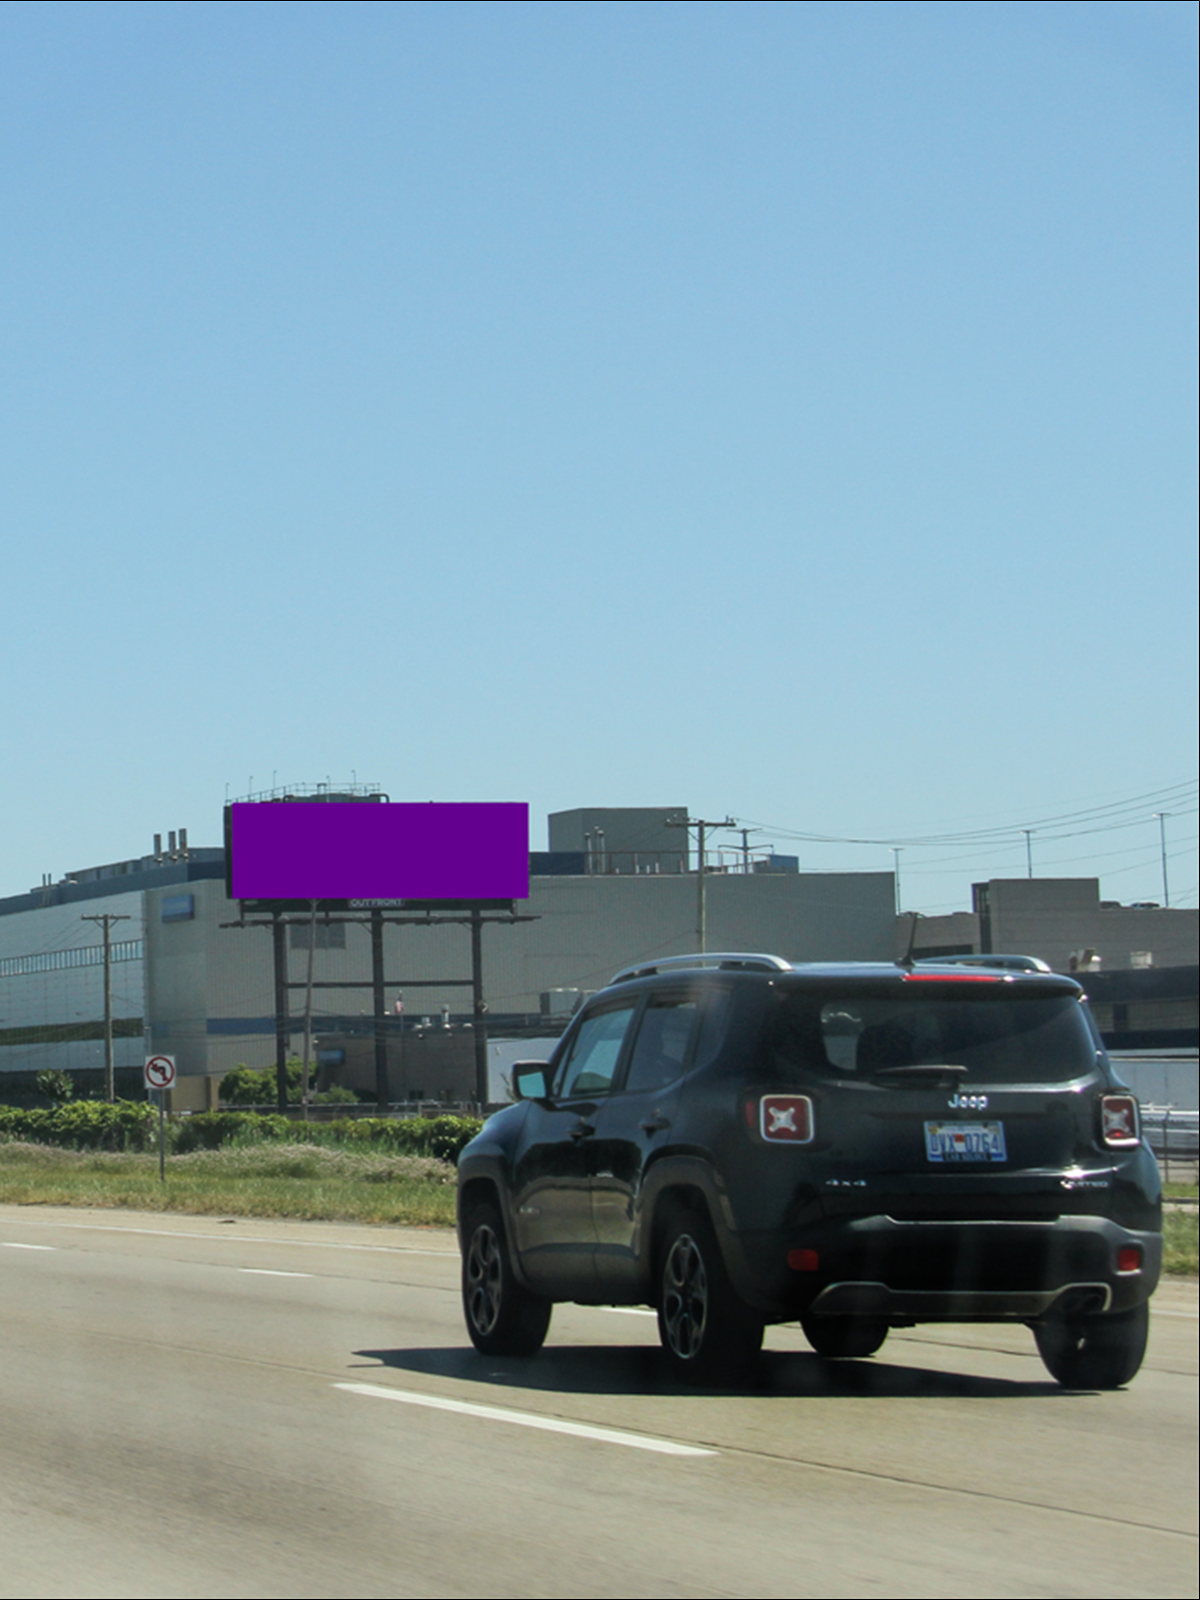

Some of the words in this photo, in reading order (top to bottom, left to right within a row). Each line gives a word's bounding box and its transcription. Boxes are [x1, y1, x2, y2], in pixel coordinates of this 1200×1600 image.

[350, 898, 403, 907] OUTFRONT
[947, 1093, 989, 1111] Jeep
[965, 1132, 999, 1152] 0764
